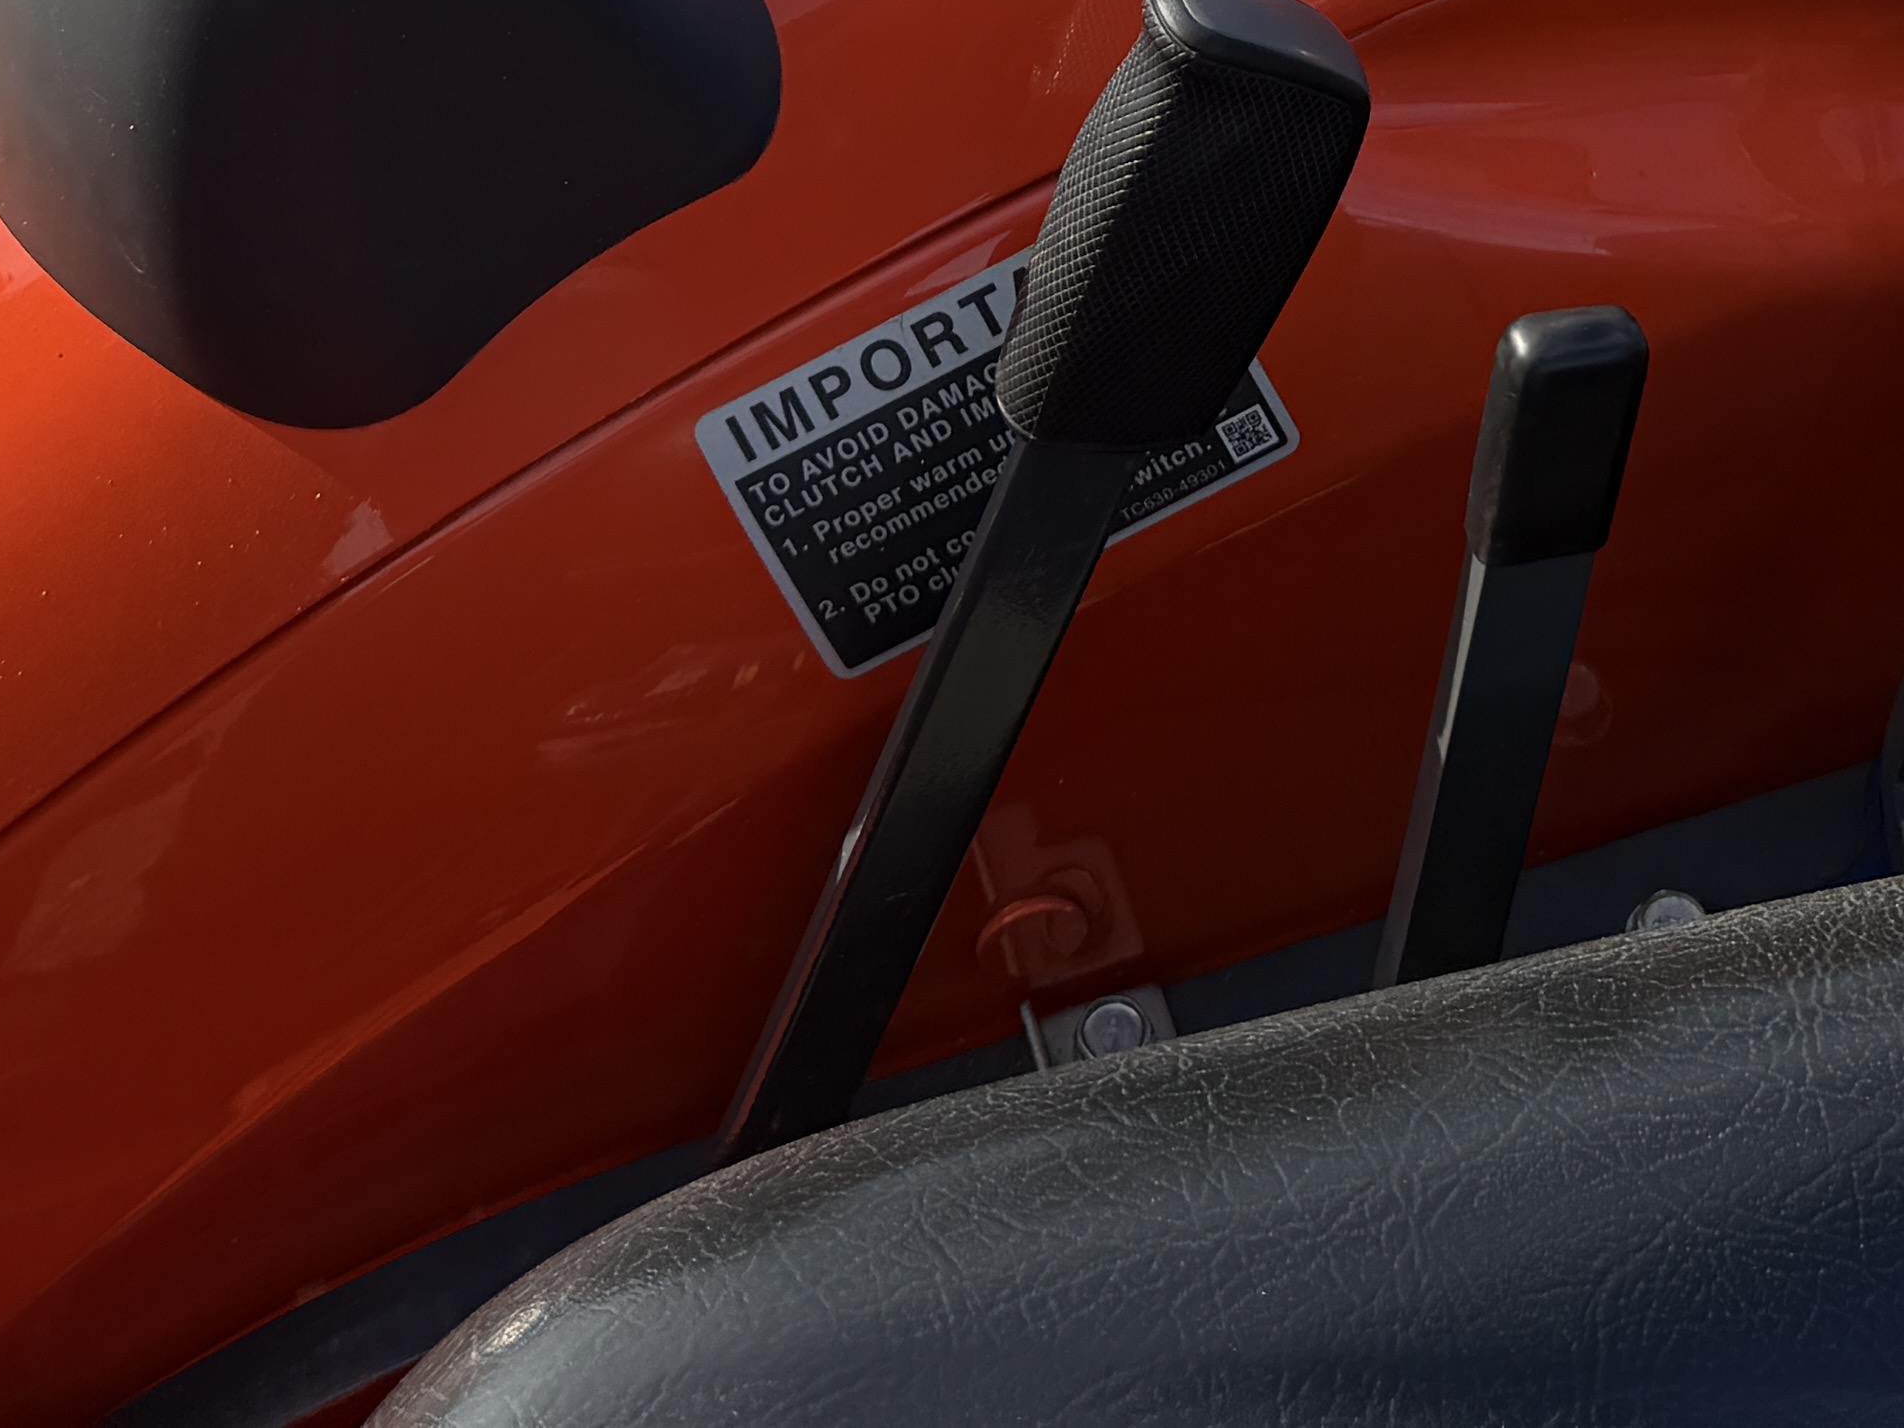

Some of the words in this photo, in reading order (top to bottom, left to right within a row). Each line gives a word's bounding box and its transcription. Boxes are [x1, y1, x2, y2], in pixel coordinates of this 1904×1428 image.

[725, 267, 1026, 462] IMPORT
[749, 472, 791, 504] TO
[801, 422, 890, 482] AVOID
[764, 454, 884, 527] CLUTCH
[893, 418, 953, 464] AND
[782, 537, 810, 557] 1.
[812, 486, 902, 543] Proper
[910, 448, 984, 493] warm
[819, 598, 846, 620] 2.
[849, 576, 889, 605] Do
[895, 546, 941, 582] not
[864, 584, 921, 624] PTO
[1128, 441, 1212, 491] witch.
